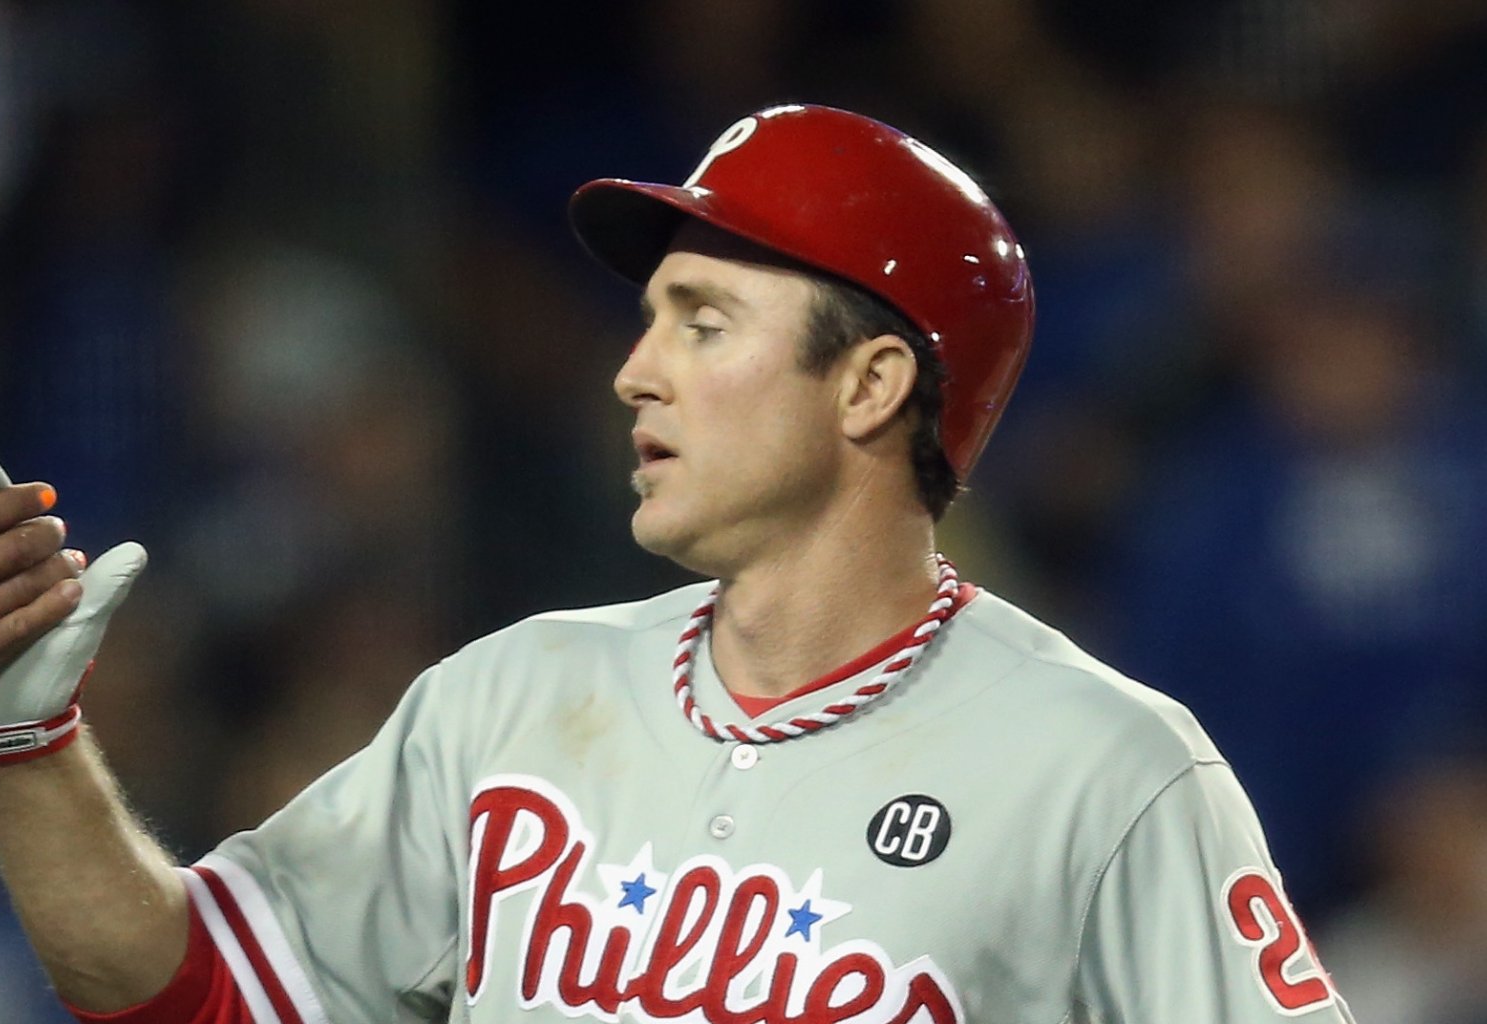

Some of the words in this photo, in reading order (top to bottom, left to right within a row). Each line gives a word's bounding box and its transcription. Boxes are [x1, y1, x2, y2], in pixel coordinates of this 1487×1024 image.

[682, 115, 758, 190] P
[873, 800, 941, 861] CB
[1224, 870, 1338, 1014] 2
